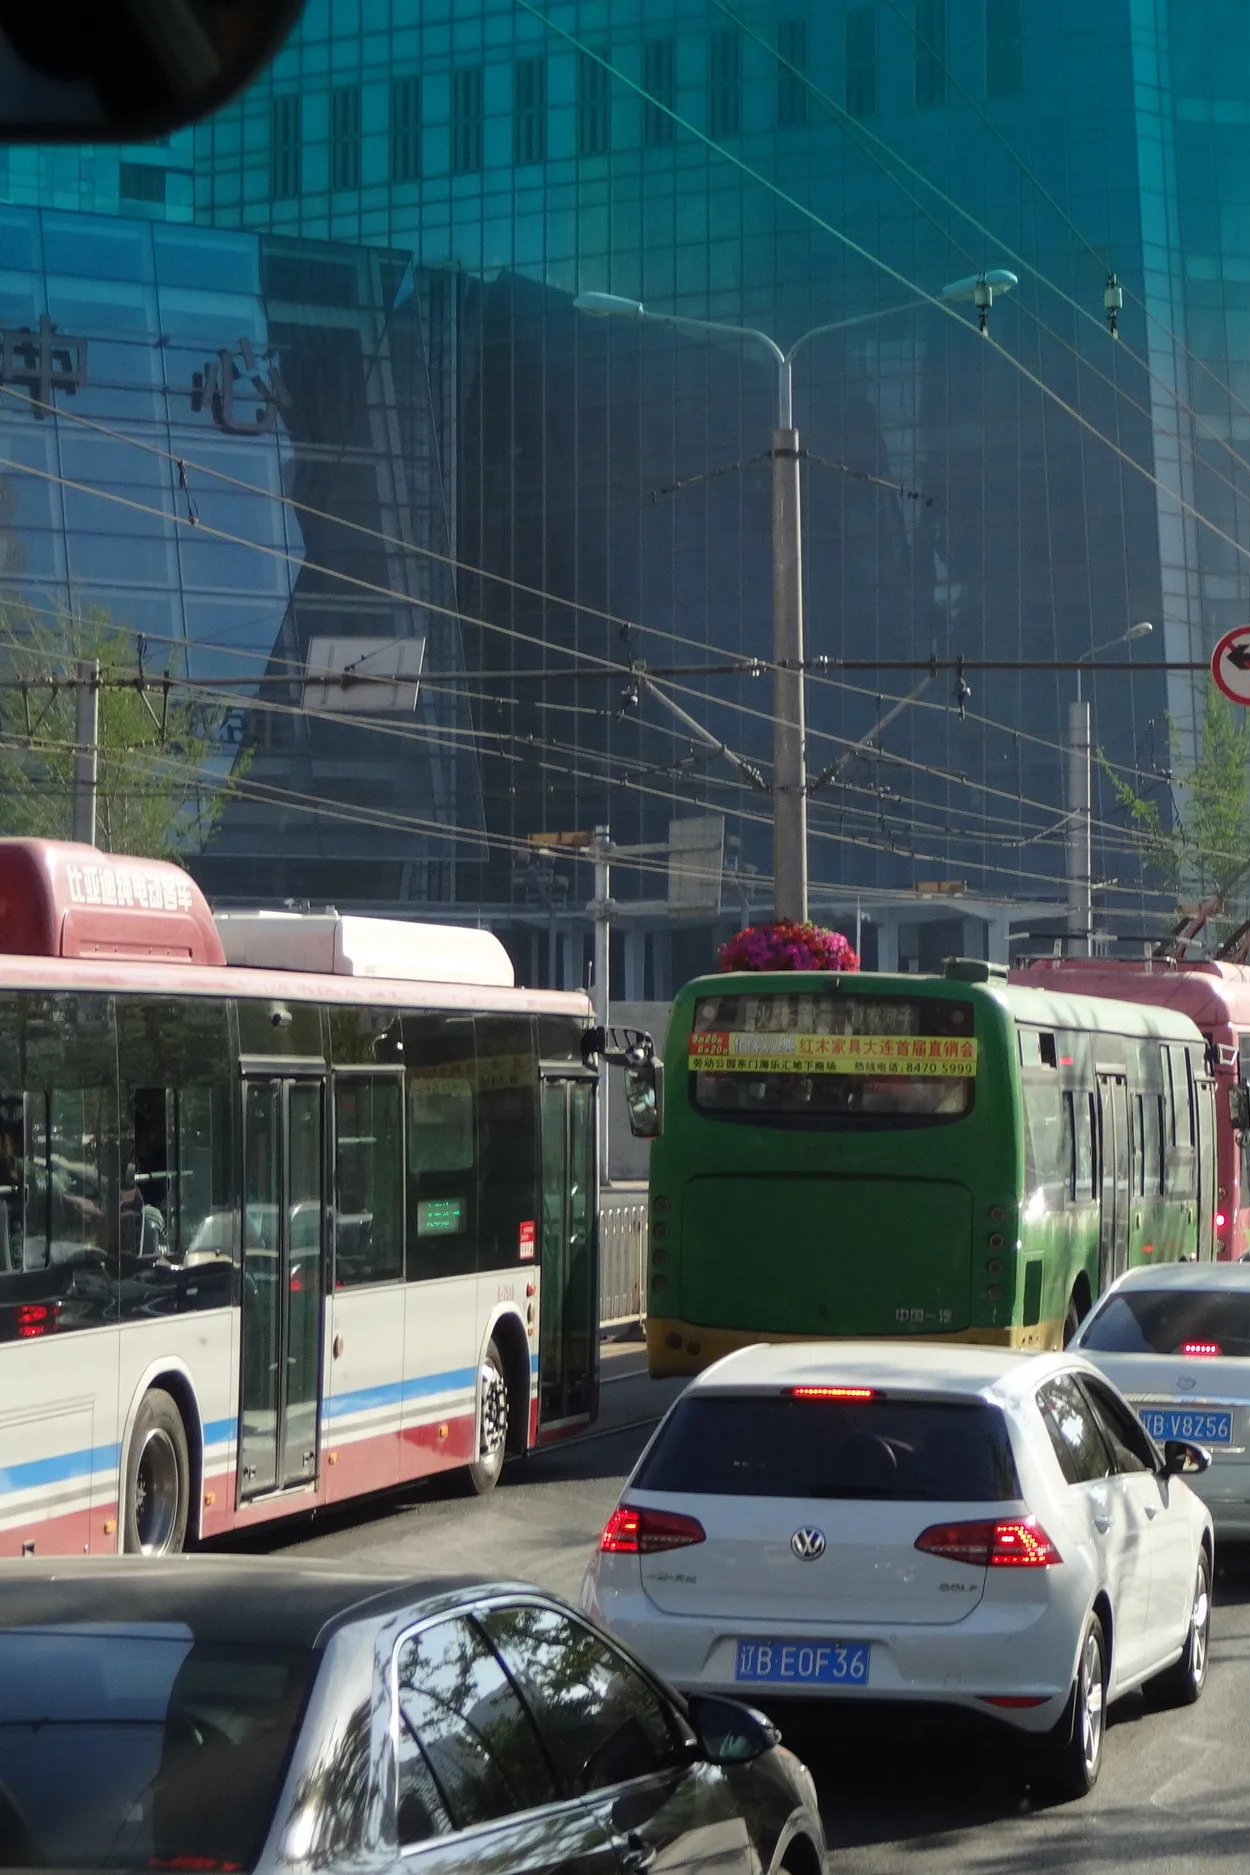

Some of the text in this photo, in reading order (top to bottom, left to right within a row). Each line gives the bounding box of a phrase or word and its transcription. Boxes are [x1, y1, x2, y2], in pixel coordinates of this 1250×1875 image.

[66, 864, 192, 911] 比亚迪纯电动客车
[941, 1063, 973, 1074] 5999
